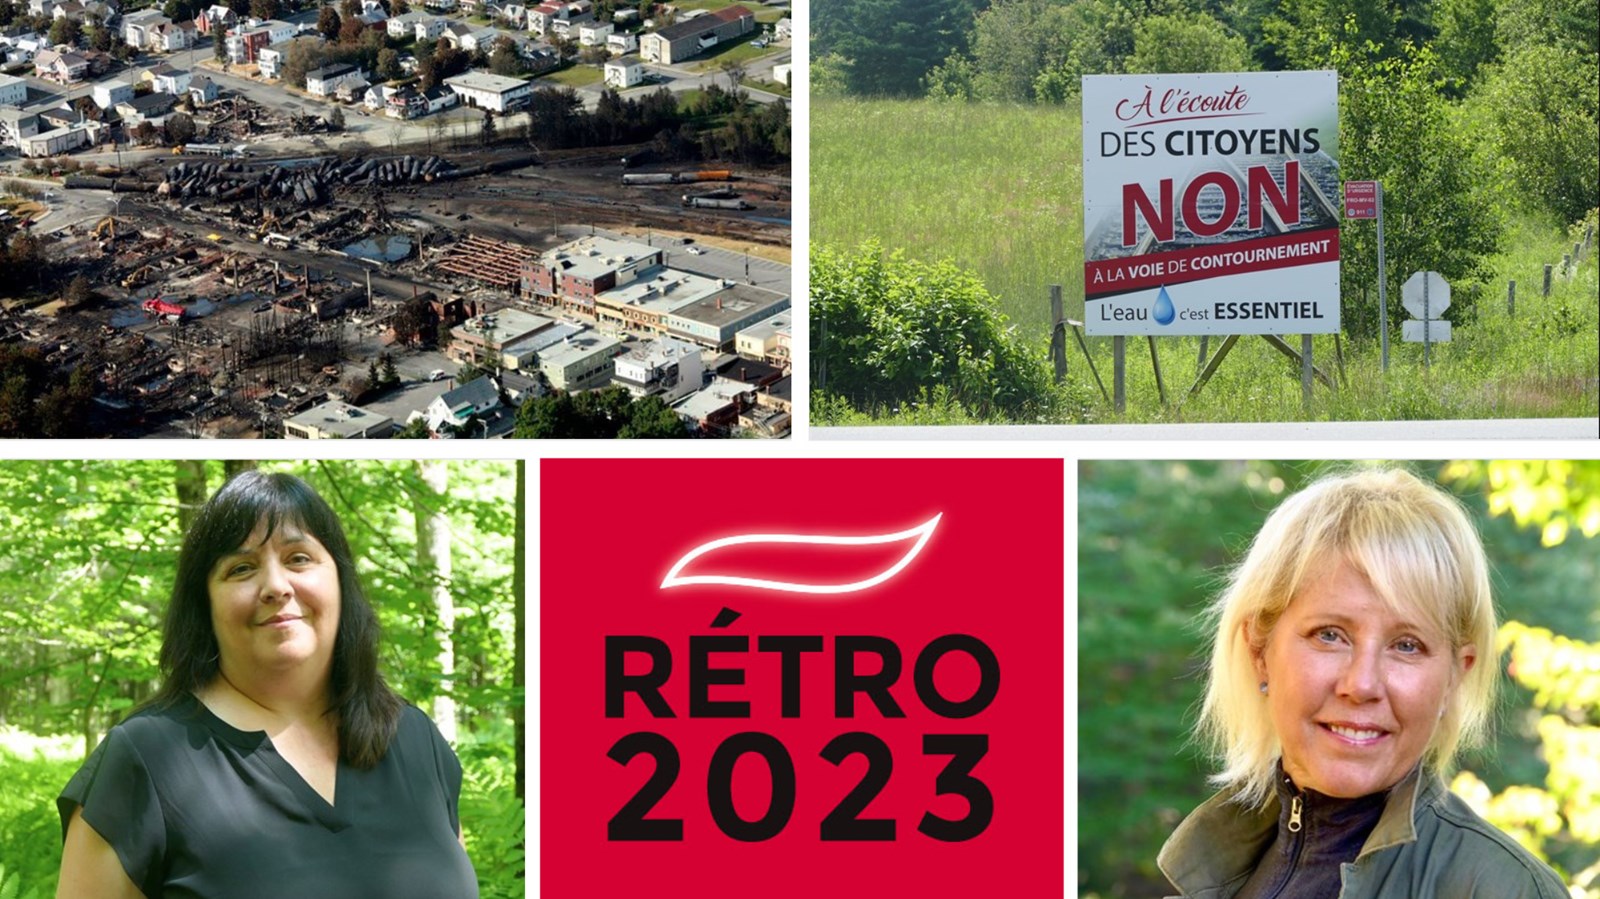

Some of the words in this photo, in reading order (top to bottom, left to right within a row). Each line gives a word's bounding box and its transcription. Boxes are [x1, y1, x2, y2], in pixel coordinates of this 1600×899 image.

[1115, 85, 1155, 121] À
[1159, 85, 1251, 114] l'écoute
[1100, 130, 1156, 158] DES
[1164, 127, 1321, 156] CITOYENS
[1122, 160, 1301, 248] NON
[1093, 268, 1104, 284] À
[1107, 268, 1125, 282] LA
[1128, 261, 1165, 280] VOIE
[1167, 260, 1188, 275] DE
[1190, 238, 1331, 271] CONTOURNEMENT
[1100, 303, 1148, 322] L'eau
[1179, 307, 1209, 321] c'est
[1214, 301, 1324, 320] ESSENTIEL
